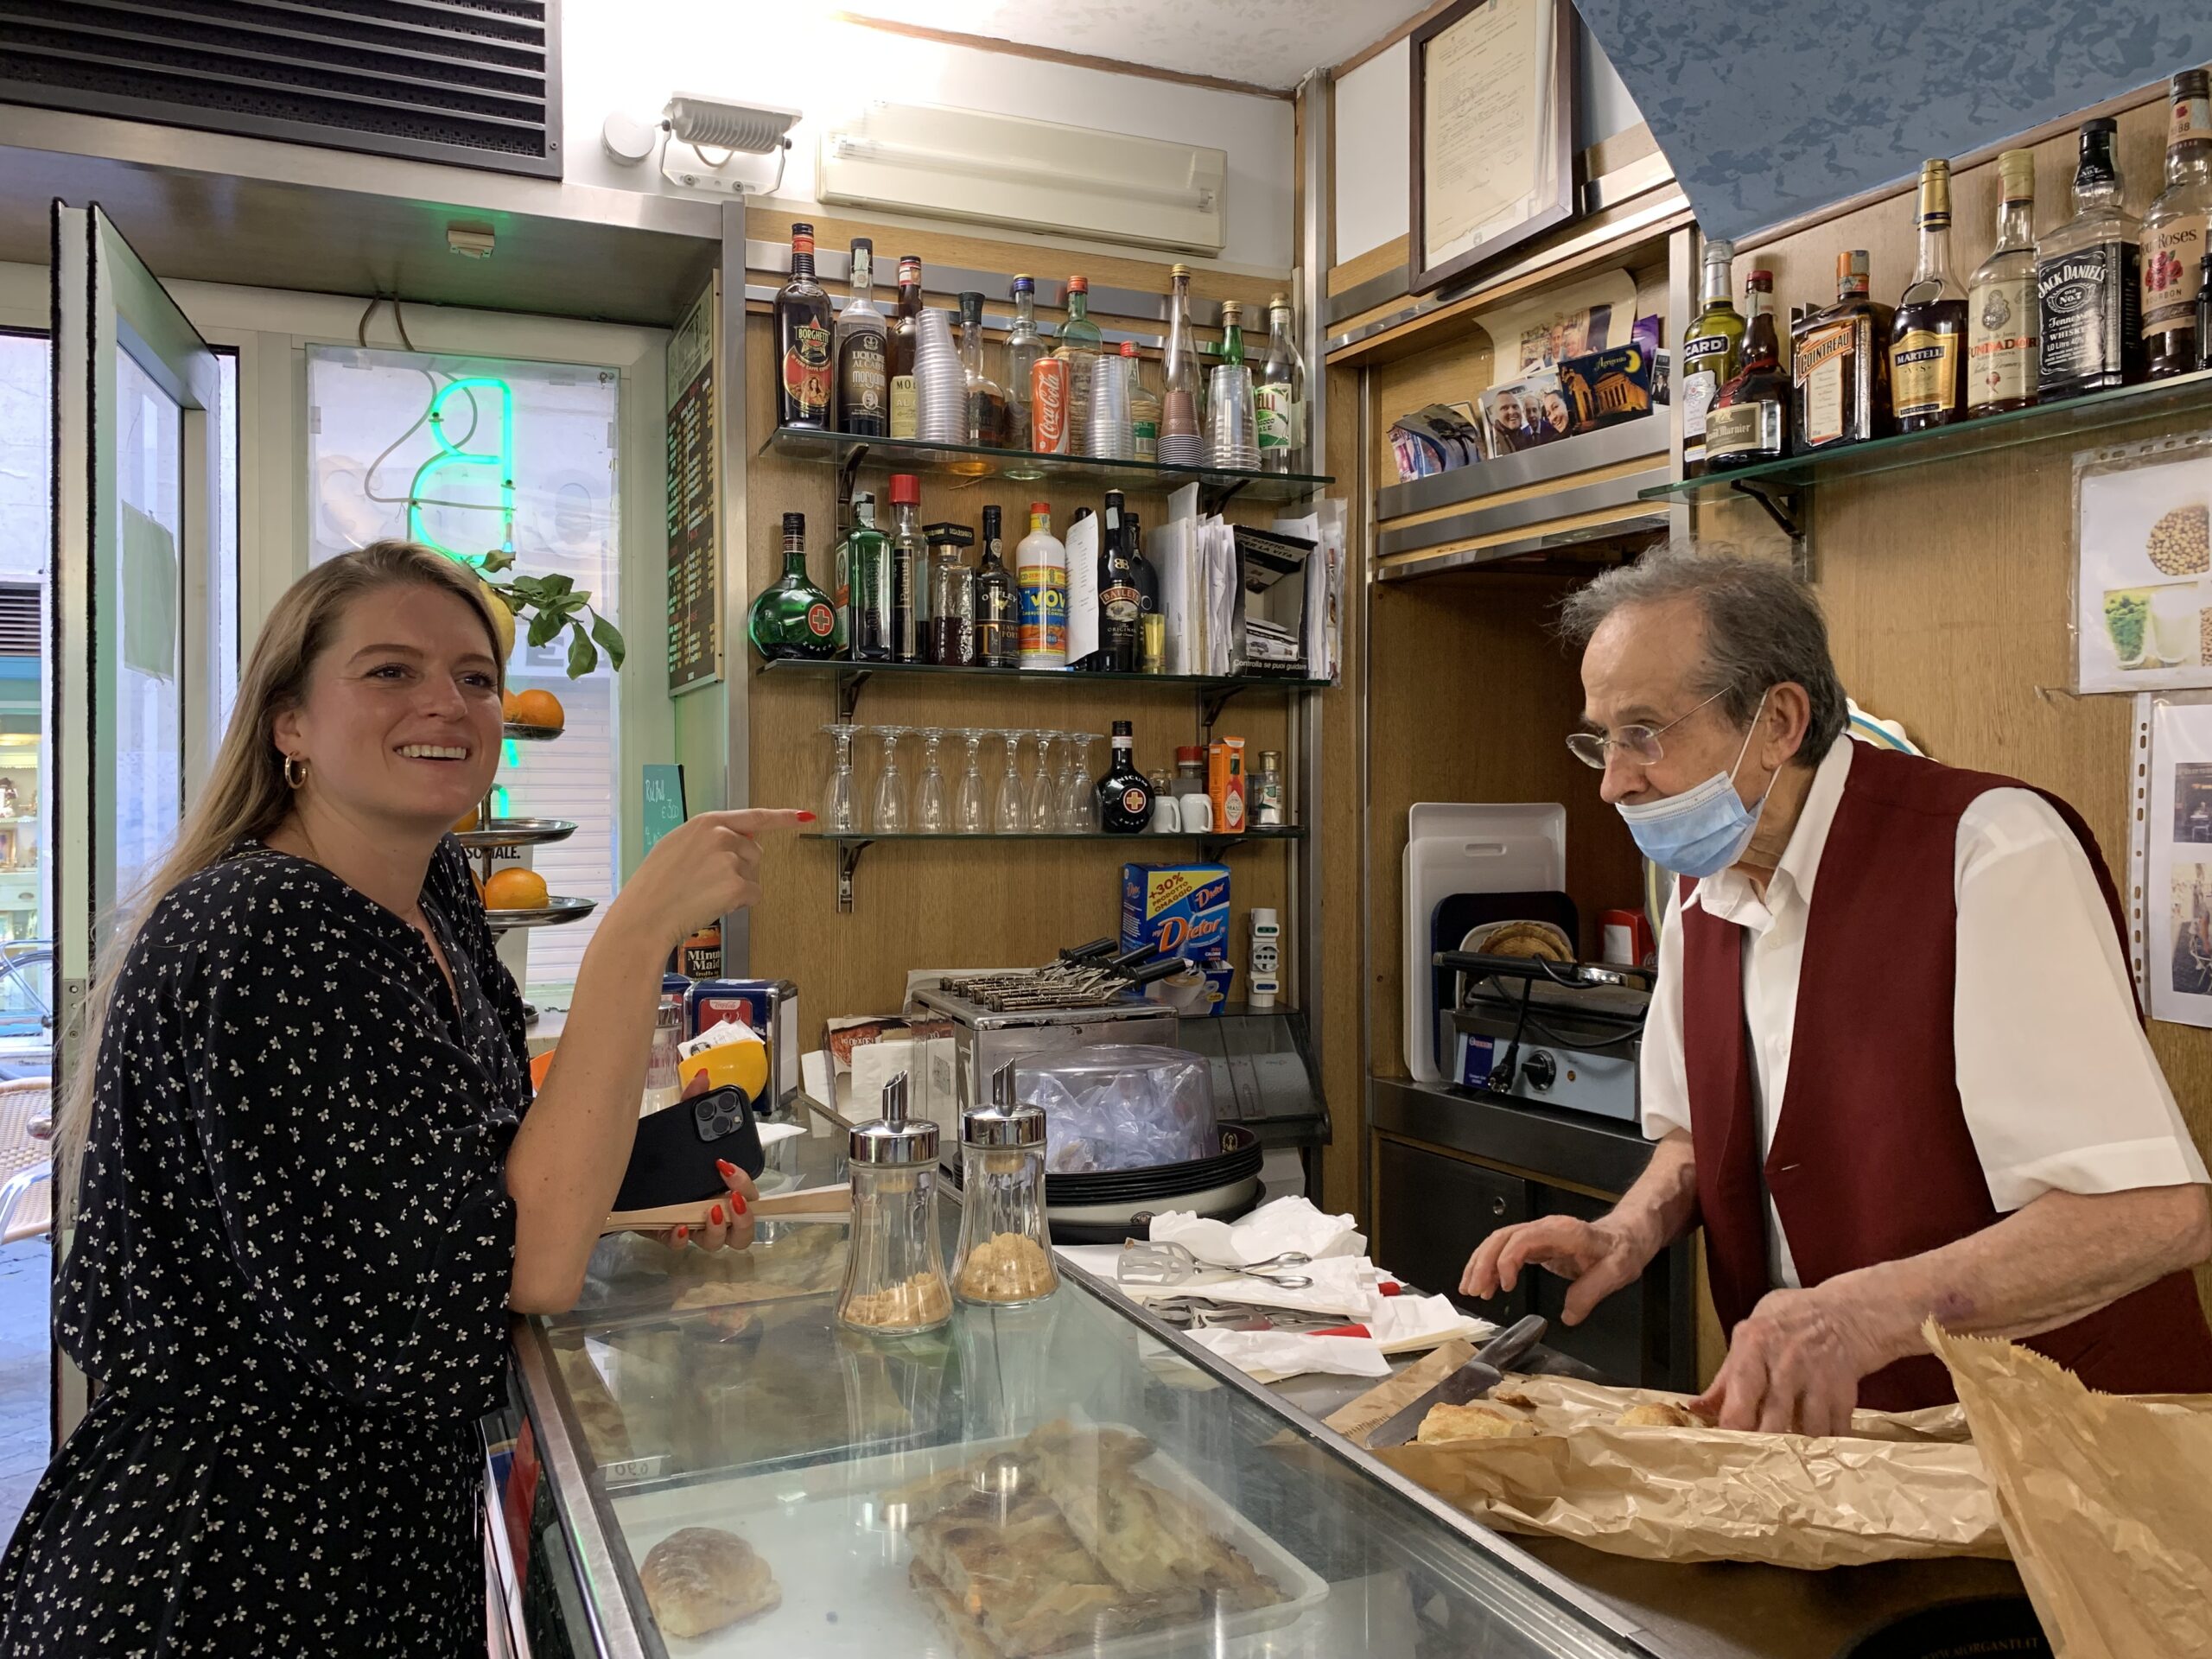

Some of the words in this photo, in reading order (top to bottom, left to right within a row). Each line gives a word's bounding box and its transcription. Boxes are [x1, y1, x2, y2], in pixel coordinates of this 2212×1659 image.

[2158, 228, 2197, 250] Roses
[2037, 271, 2063, 299] JACK
[2063, 264, 2108, 283] DANIEL'S
[798, 328, 830, 343] BORGHETTI
[1685, 339, 1723, 357] CARD
[1801, 331, 1850, 374] COINTREAU
[900, 562, 910, 603] Petrus
[1103, 588, 1140, 602] BAILEYS
[1233, 658, 1262, 668] Controlla
[1272, 662, 1286, 671] puoi
[466, 846, 521, 860] SOIALE.
[1148, 872, 1185, 900] +30%
[1152, 881, 1189, 907] PRODOTTO
[1154, 886, 1193, 912] OMAGGIO
[1158, 916, 1224, 953] Dietor
[692, 959, 720, 970] Maid
